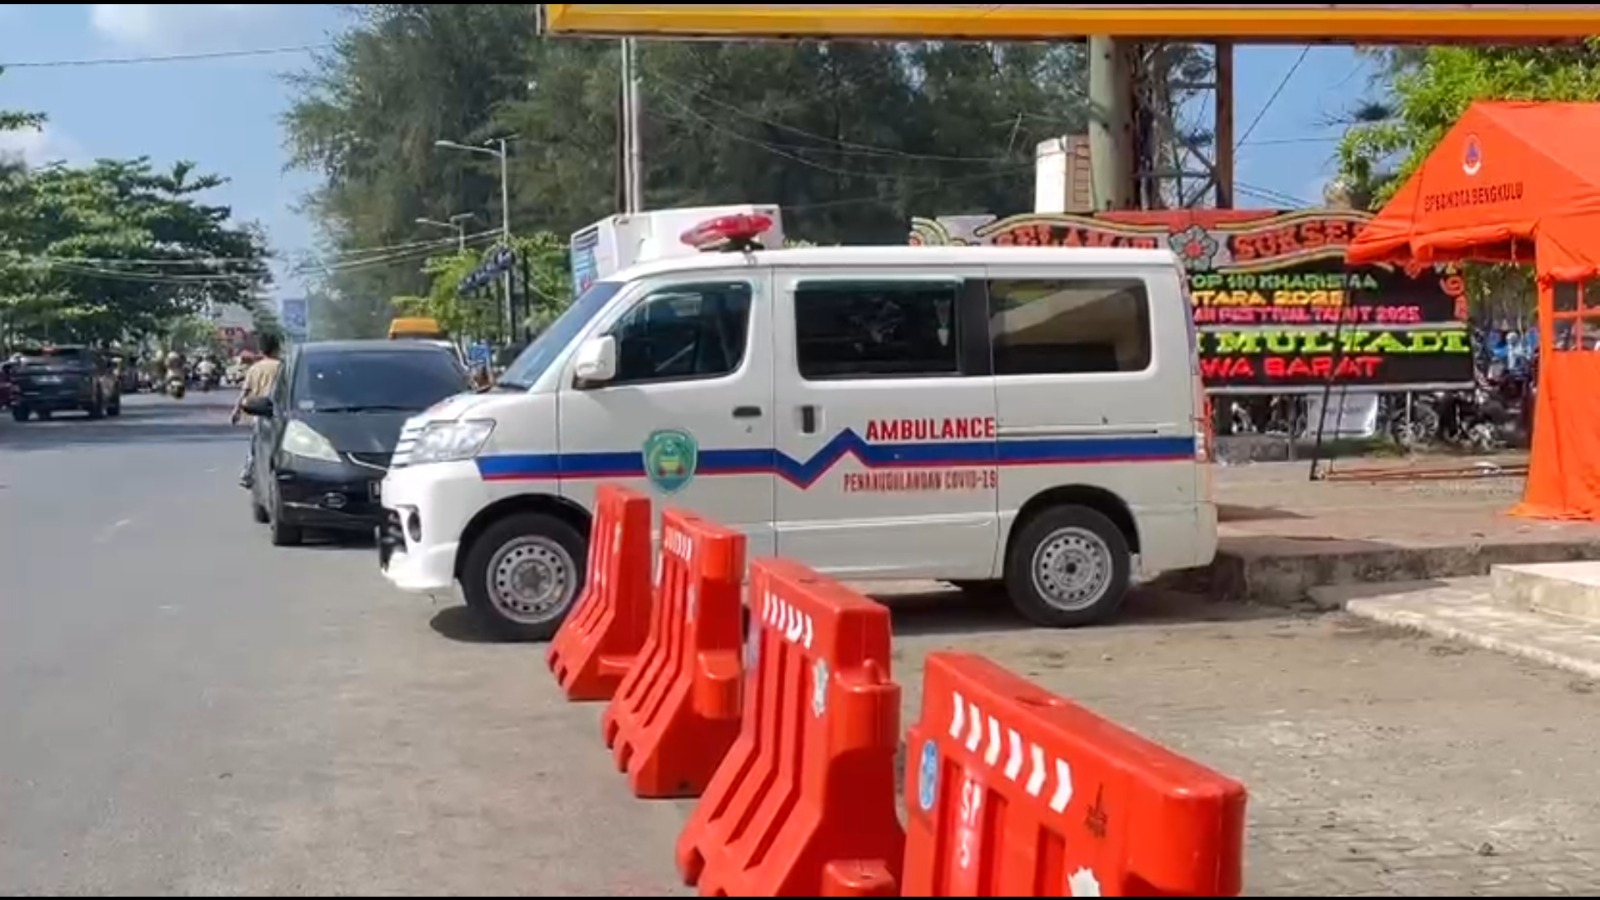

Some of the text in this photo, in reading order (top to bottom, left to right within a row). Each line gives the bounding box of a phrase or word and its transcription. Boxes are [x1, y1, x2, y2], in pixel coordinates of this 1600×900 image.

[1471, 182, 1524, 206] BENGKULU
[1214, 331, 1470, 353] MULYADI
[1263, 356, 1383, 378] BARAT
[865, 416, 996, 441] AMBULANCE
